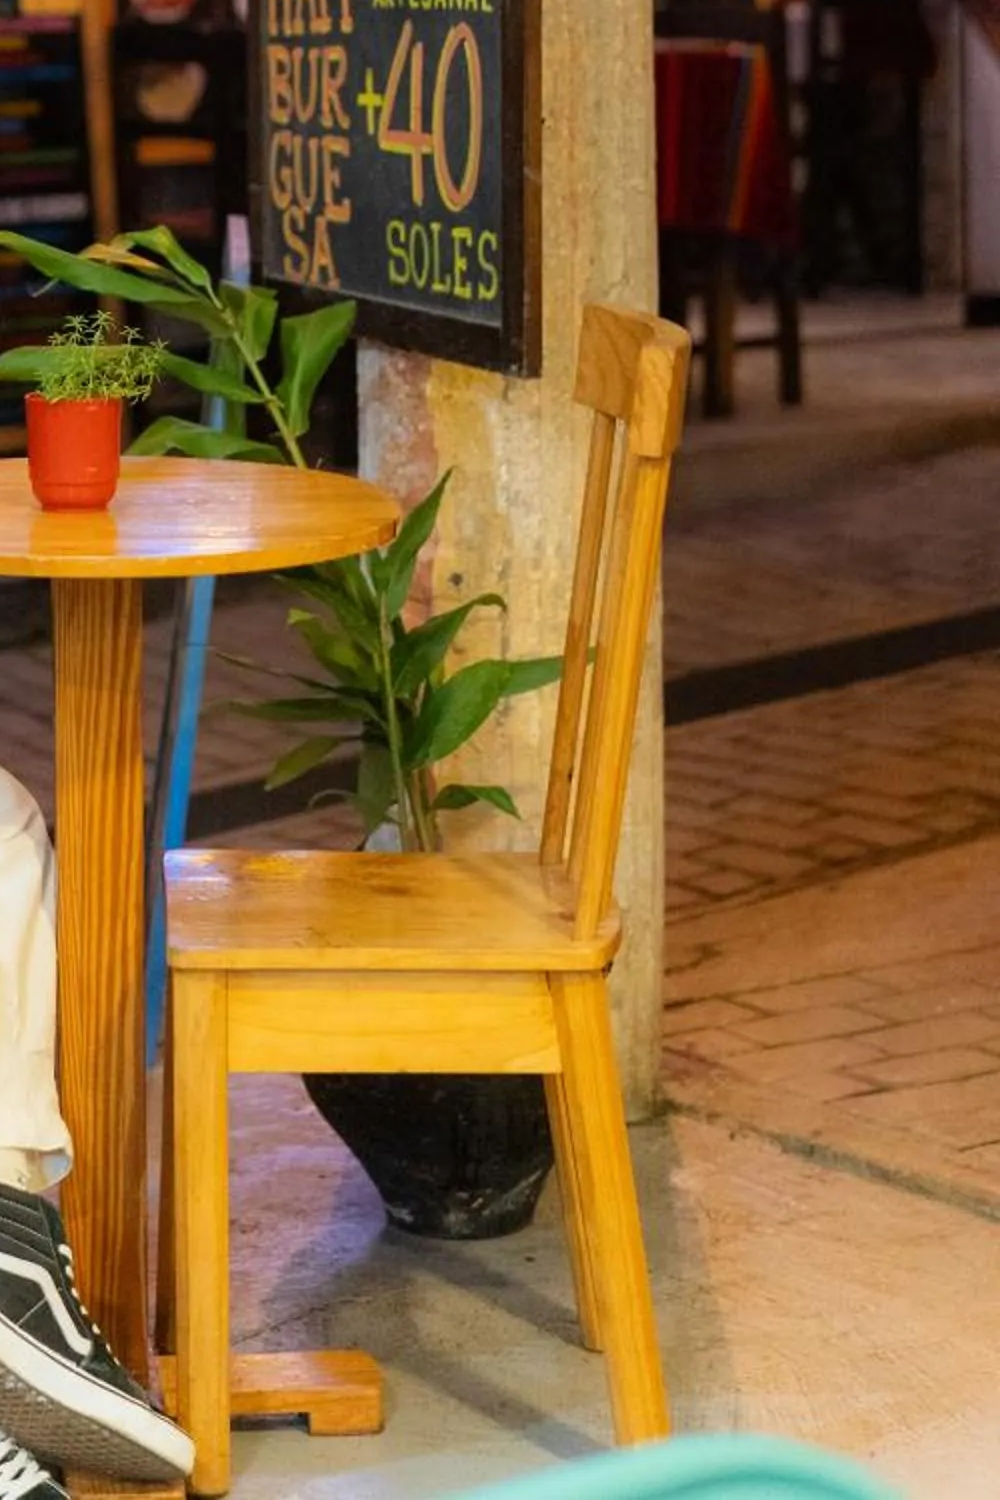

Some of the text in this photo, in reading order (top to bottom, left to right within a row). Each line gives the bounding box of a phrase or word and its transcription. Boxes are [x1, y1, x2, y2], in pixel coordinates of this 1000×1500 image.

[267, 45, 350, 130] BUR
[269, 129, 352, 224] GUE
[282, 205, 341, 291] SA
[386, 220, 498, 301] SOLES
